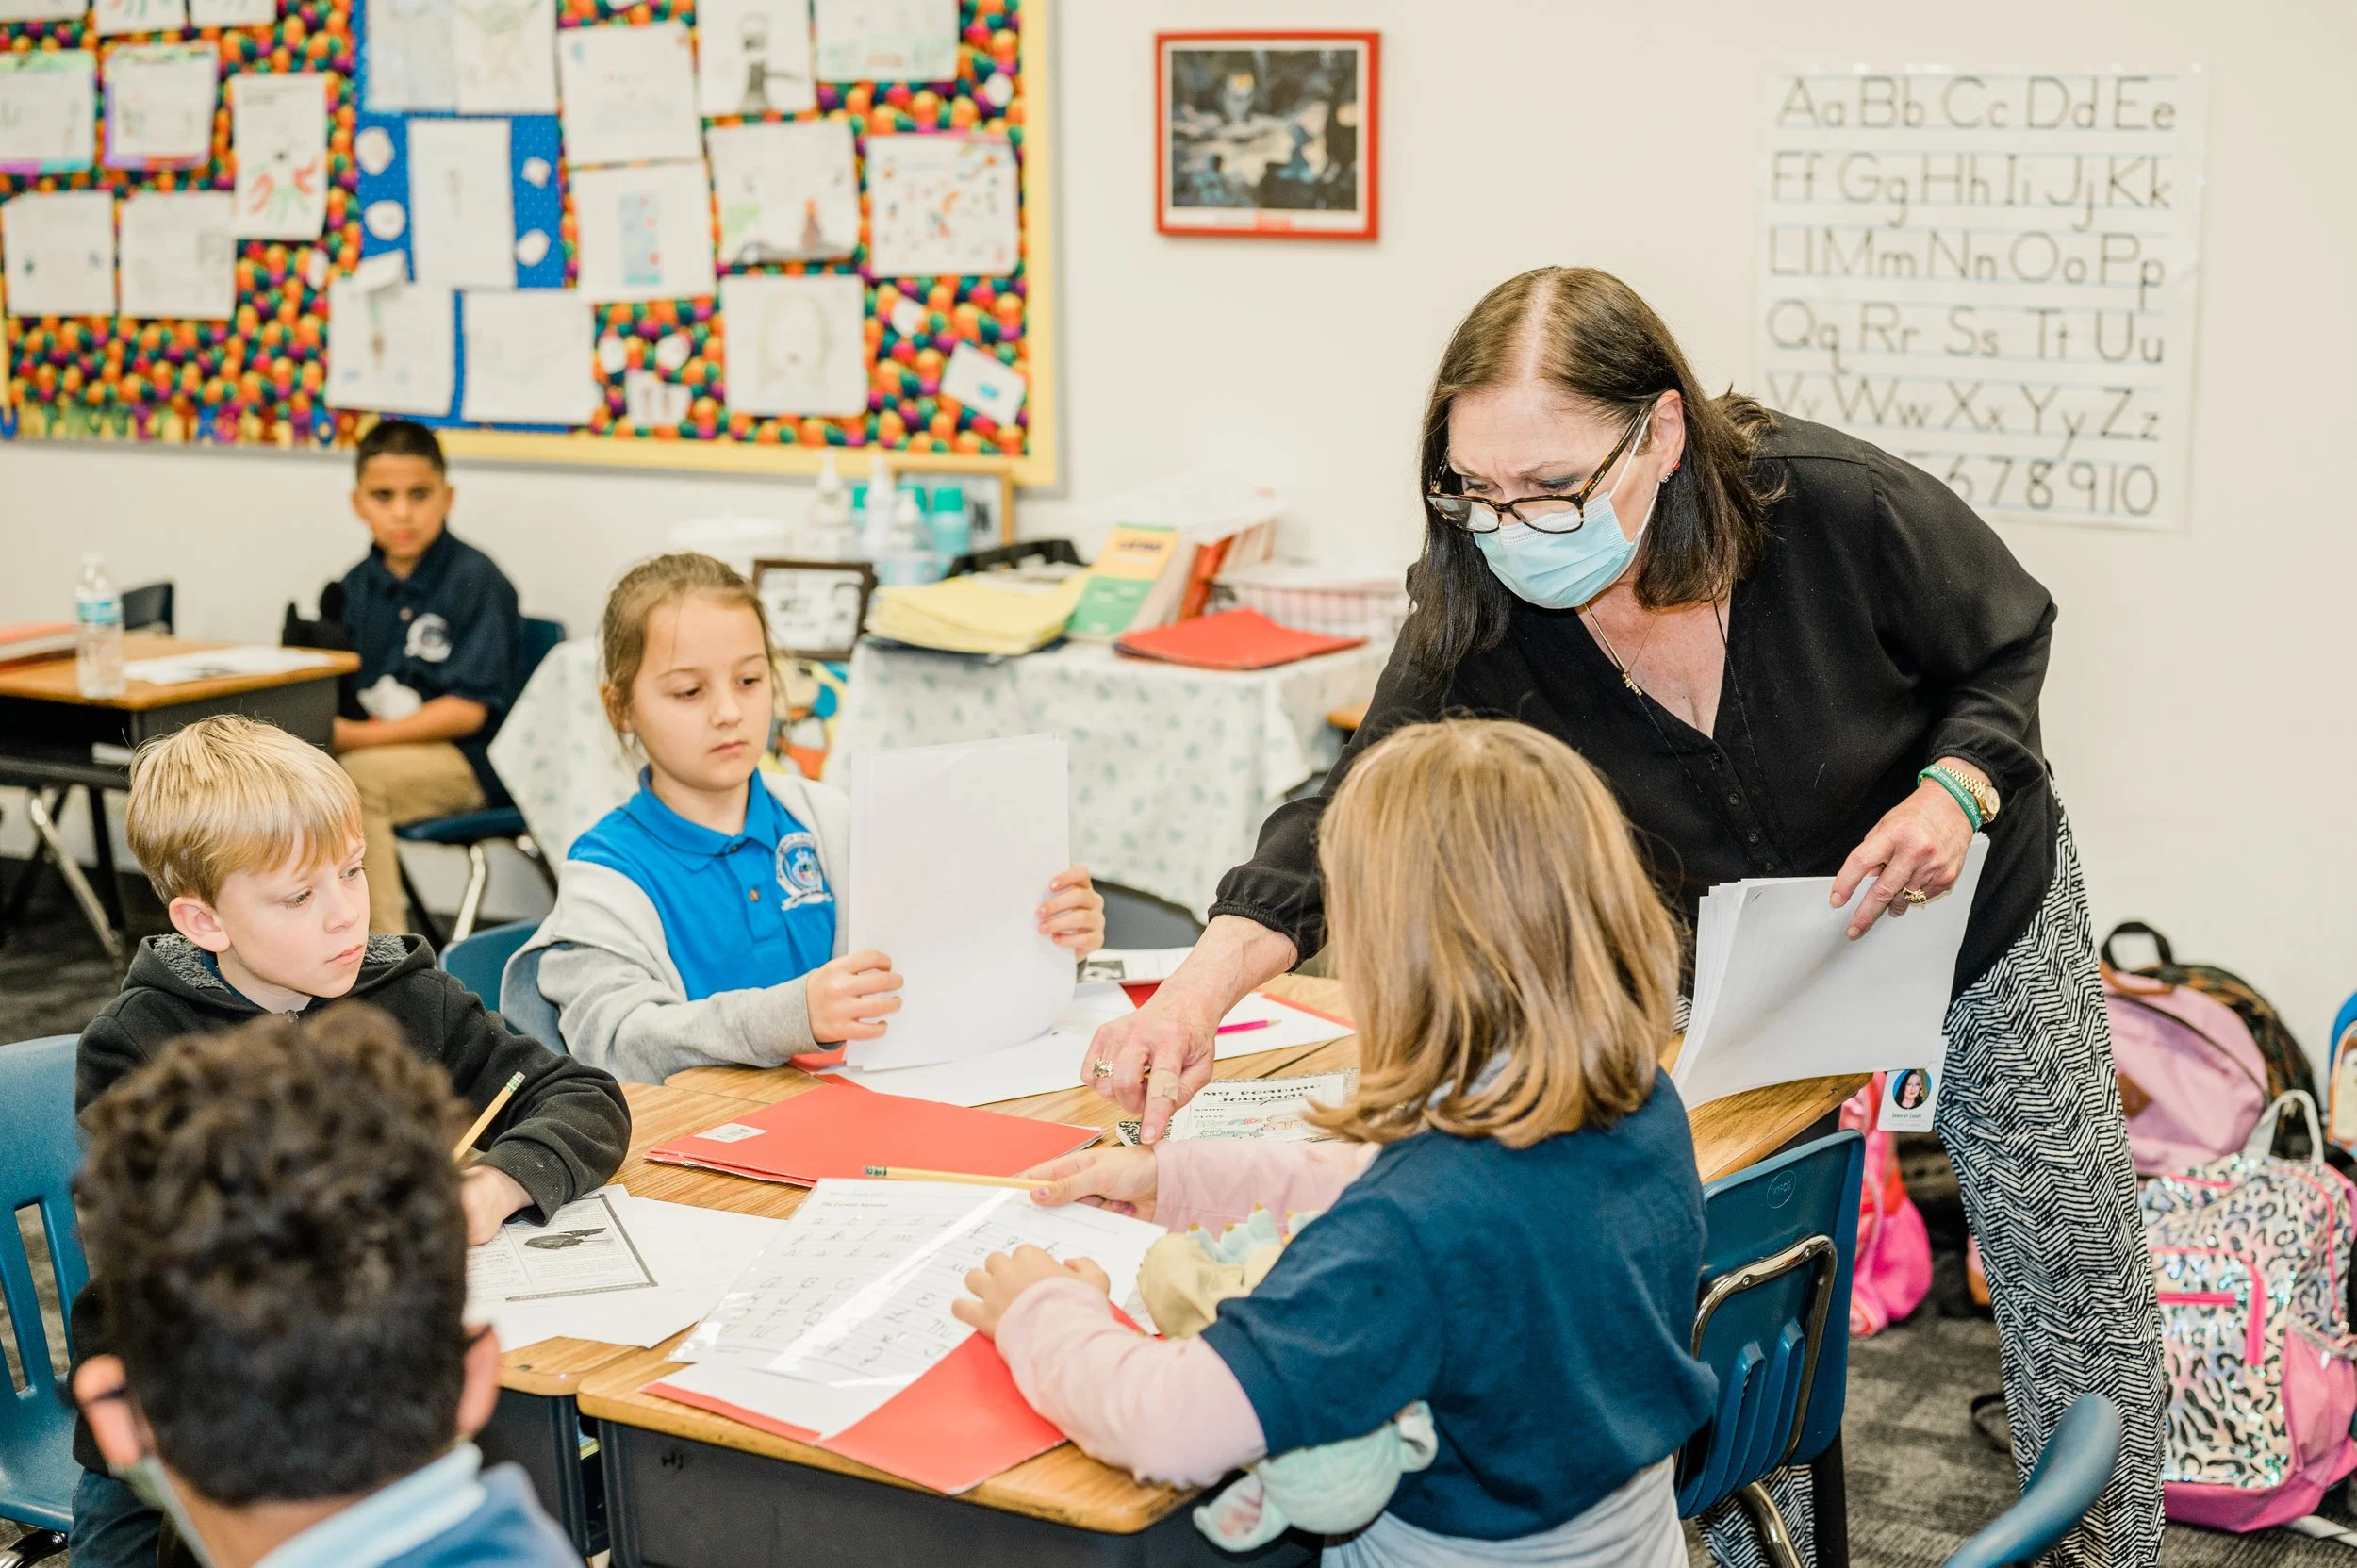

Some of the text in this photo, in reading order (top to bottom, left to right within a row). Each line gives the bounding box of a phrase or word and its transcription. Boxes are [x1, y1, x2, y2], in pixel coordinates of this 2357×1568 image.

[1776, 75, 2177, 130] Aa Bb Cc Dd Ee
[1771, 151, 2172, 232] Ff Gg Hh Ii Jj Kk
[1769, 225, 2165, 310] Ll Mm Nn Oo Pp
[1765, 298, 2163, 374] Qq Rr Ss Tt Uu
[1830, 375, 1933, 427] Ww
[1943, 380, 2005, 432] Xx
[2019, 382, 2085, 468] Yy
[2100, 386, 2160, 441] Zz
[1988, 455, 2013, 508] 7
[2026, 458, 2054, 510] 8
[2068, 461, 2097, 512] 9
[2108, 463, 2159, 517] 10
